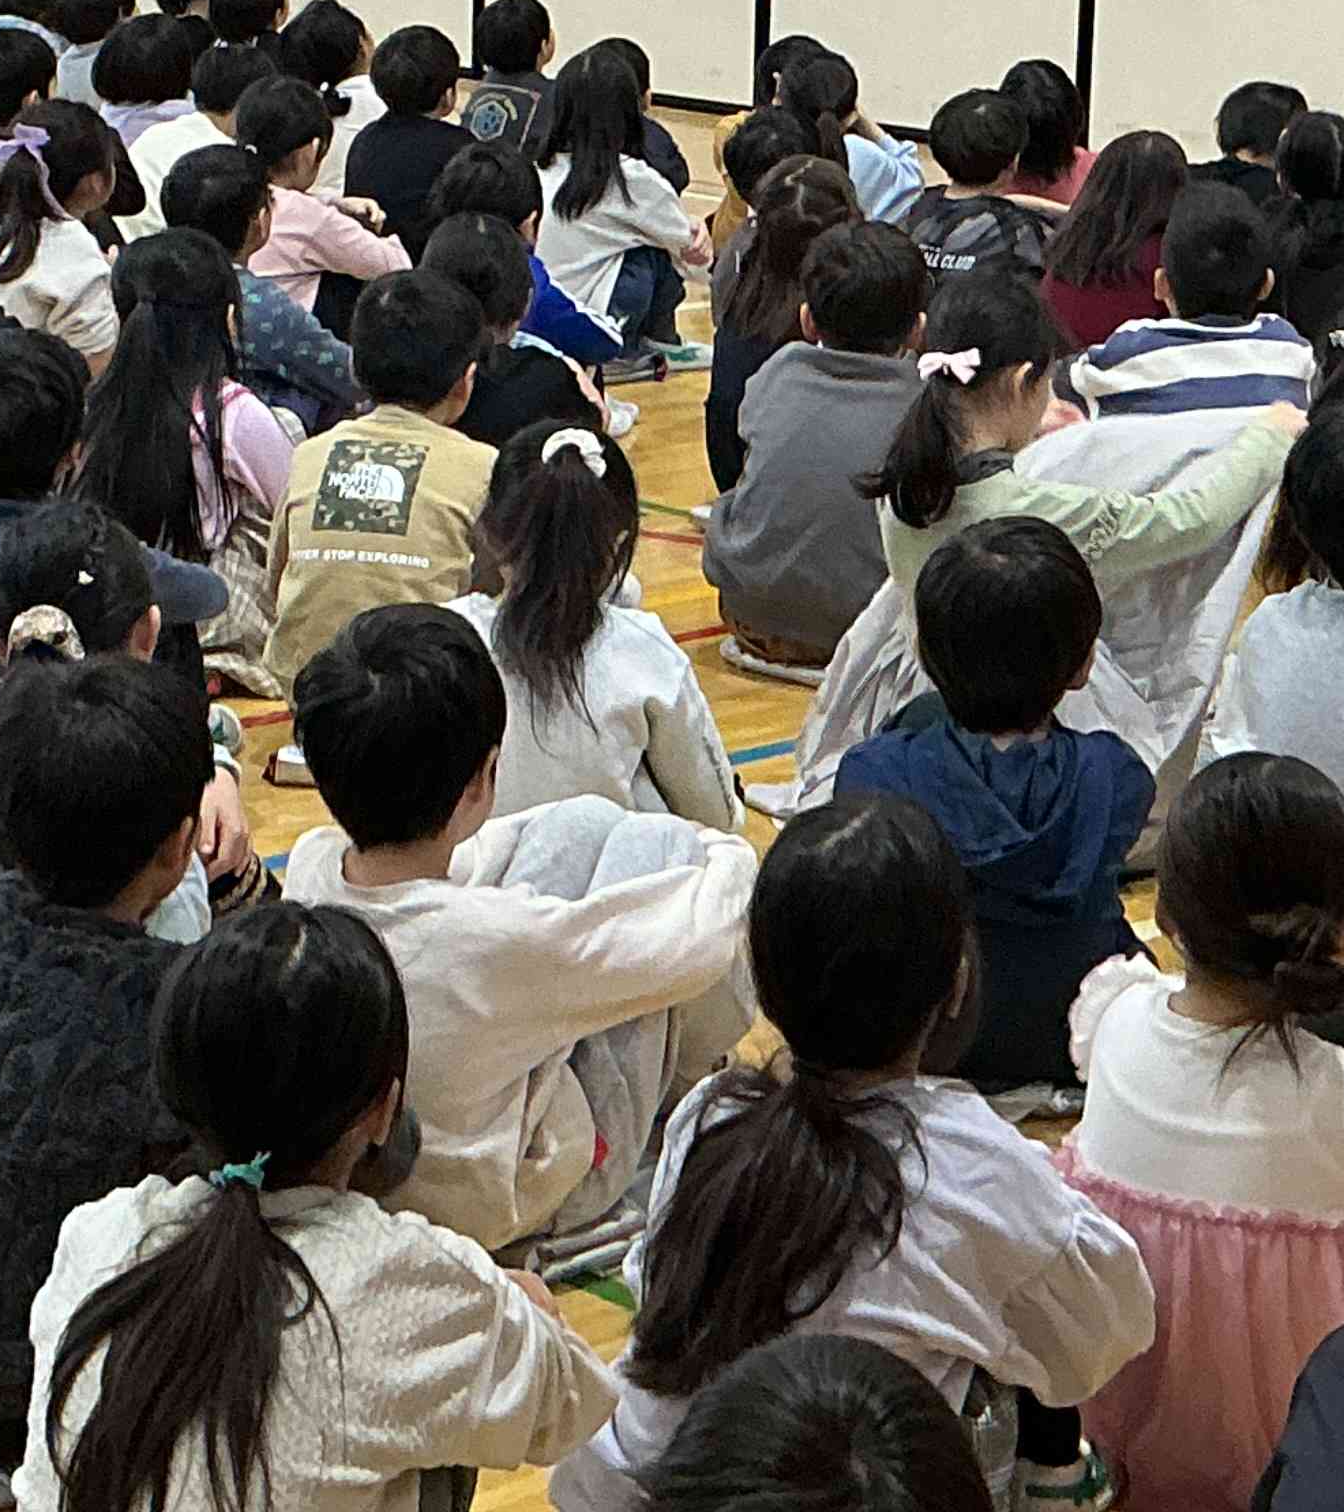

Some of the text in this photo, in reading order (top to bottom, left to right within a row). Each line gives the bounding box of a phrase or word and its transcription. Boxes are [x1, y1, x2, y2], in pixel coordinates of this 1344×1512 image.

[327, 471, 378, 489] NORTH
[323, 548, 356, 562] STOP
[357, 550, 431, 568] EXPLORING
